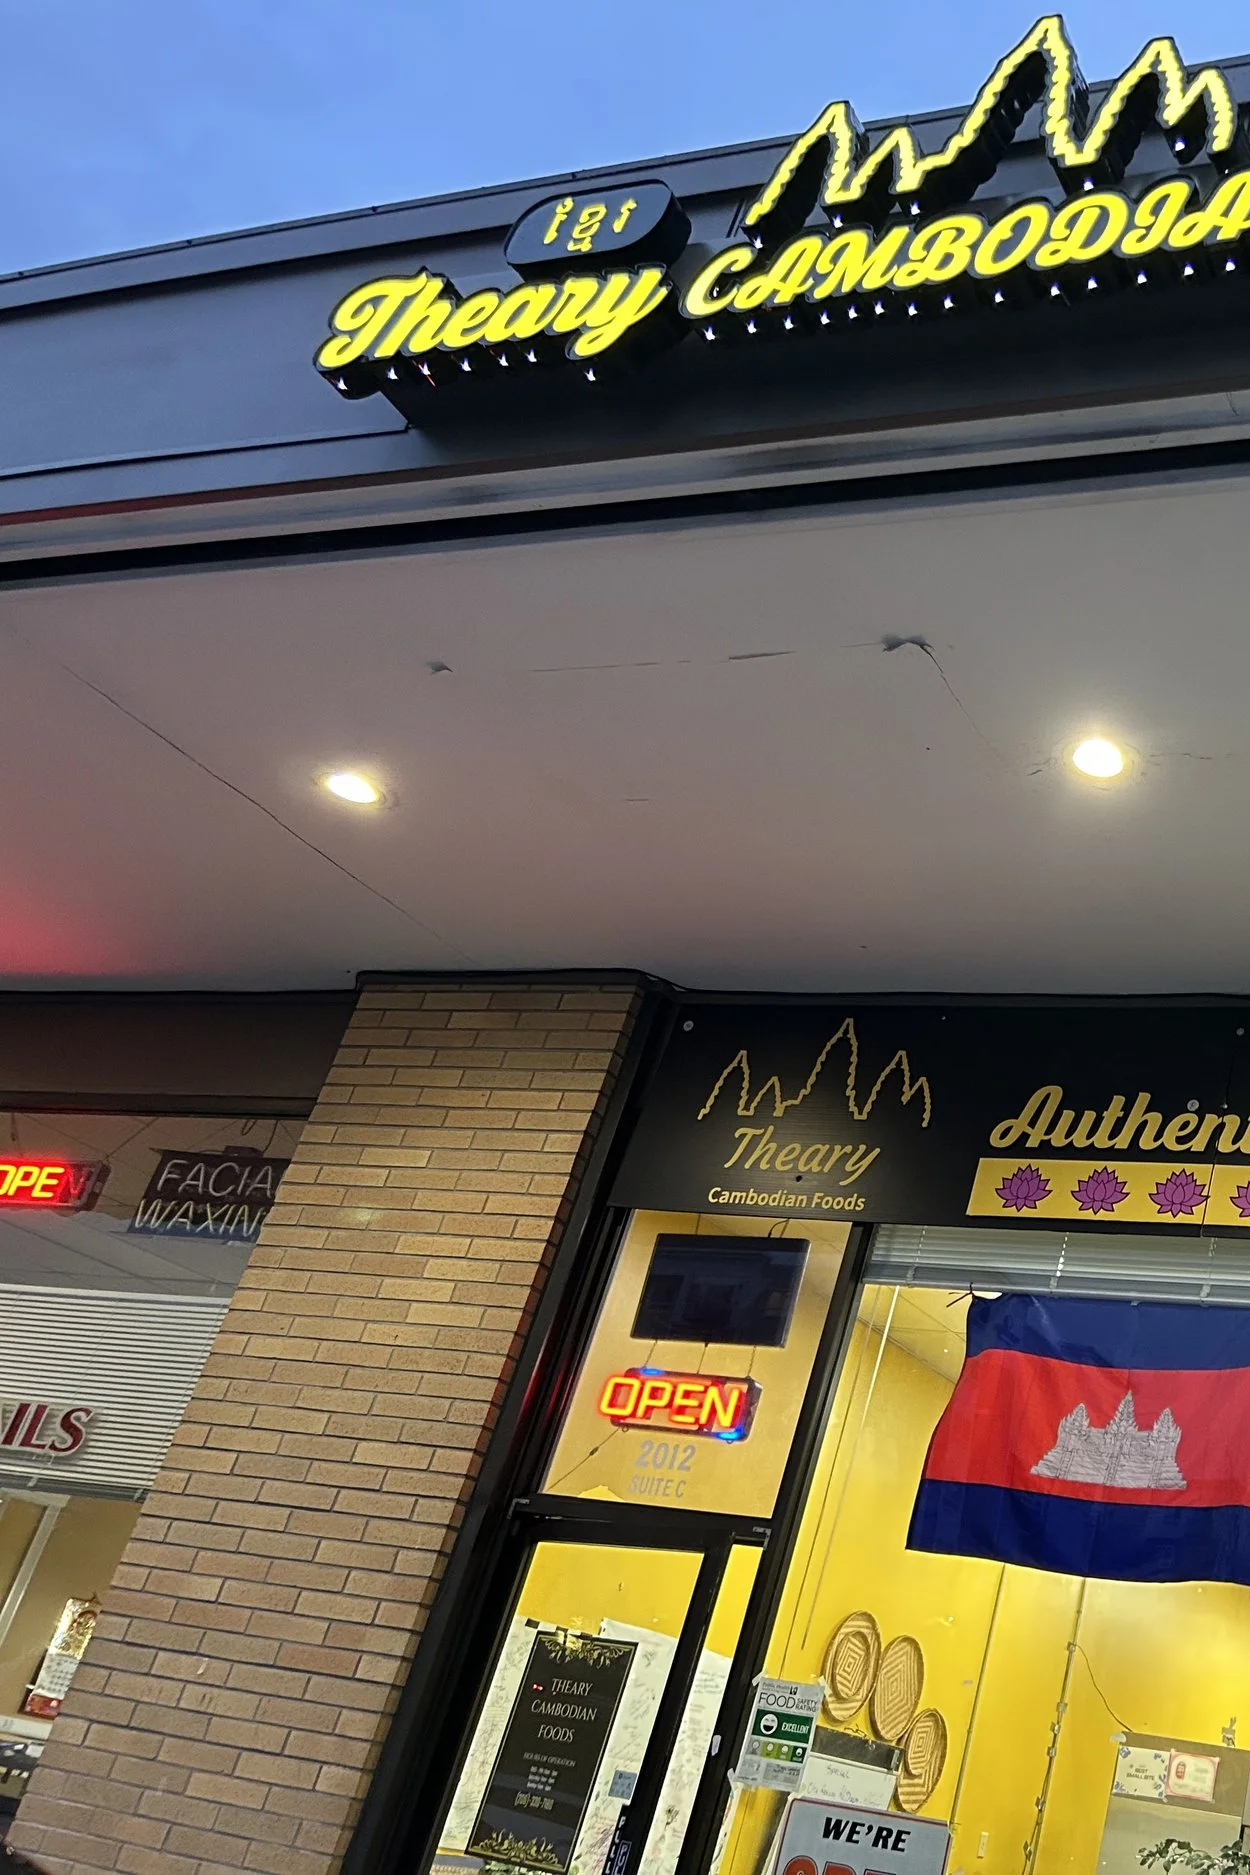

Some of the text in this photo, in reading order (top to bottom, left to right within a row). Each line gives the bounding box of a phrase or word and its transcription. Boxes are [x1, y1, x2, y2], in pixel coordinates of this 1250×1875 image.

[313, 262, 668, 368] Theary
[724, 1125, 881, 1187] Theary
[156, 1159, 273, 1199] FACIA
[707, 1186, 866, 1212] Cambodian Foods
[134, 1198, 268, 1237] WAXIN
[599, 1375, 741, 1429] OPEN
[0, 1402, 95, 1454] ILS
[634, 1439, 697, 1473] 2012
[627, 1474, 688, 1498] SUITE C
[551, 1678, 593, 1696] THEARY
[531, 1699, 597, 1721] CAMBODIAN
[758, 1692, 796, 1709] FOOD
[795, 1703, 817, 1713] RATING
[797, 1697, 818, 1706] SAFETY
[537, 1724, 575, 1743] FOODS
[781, 1722, 810, 1734] EXCELLENT
[822, 1816, 912, 1853] WE'RE
